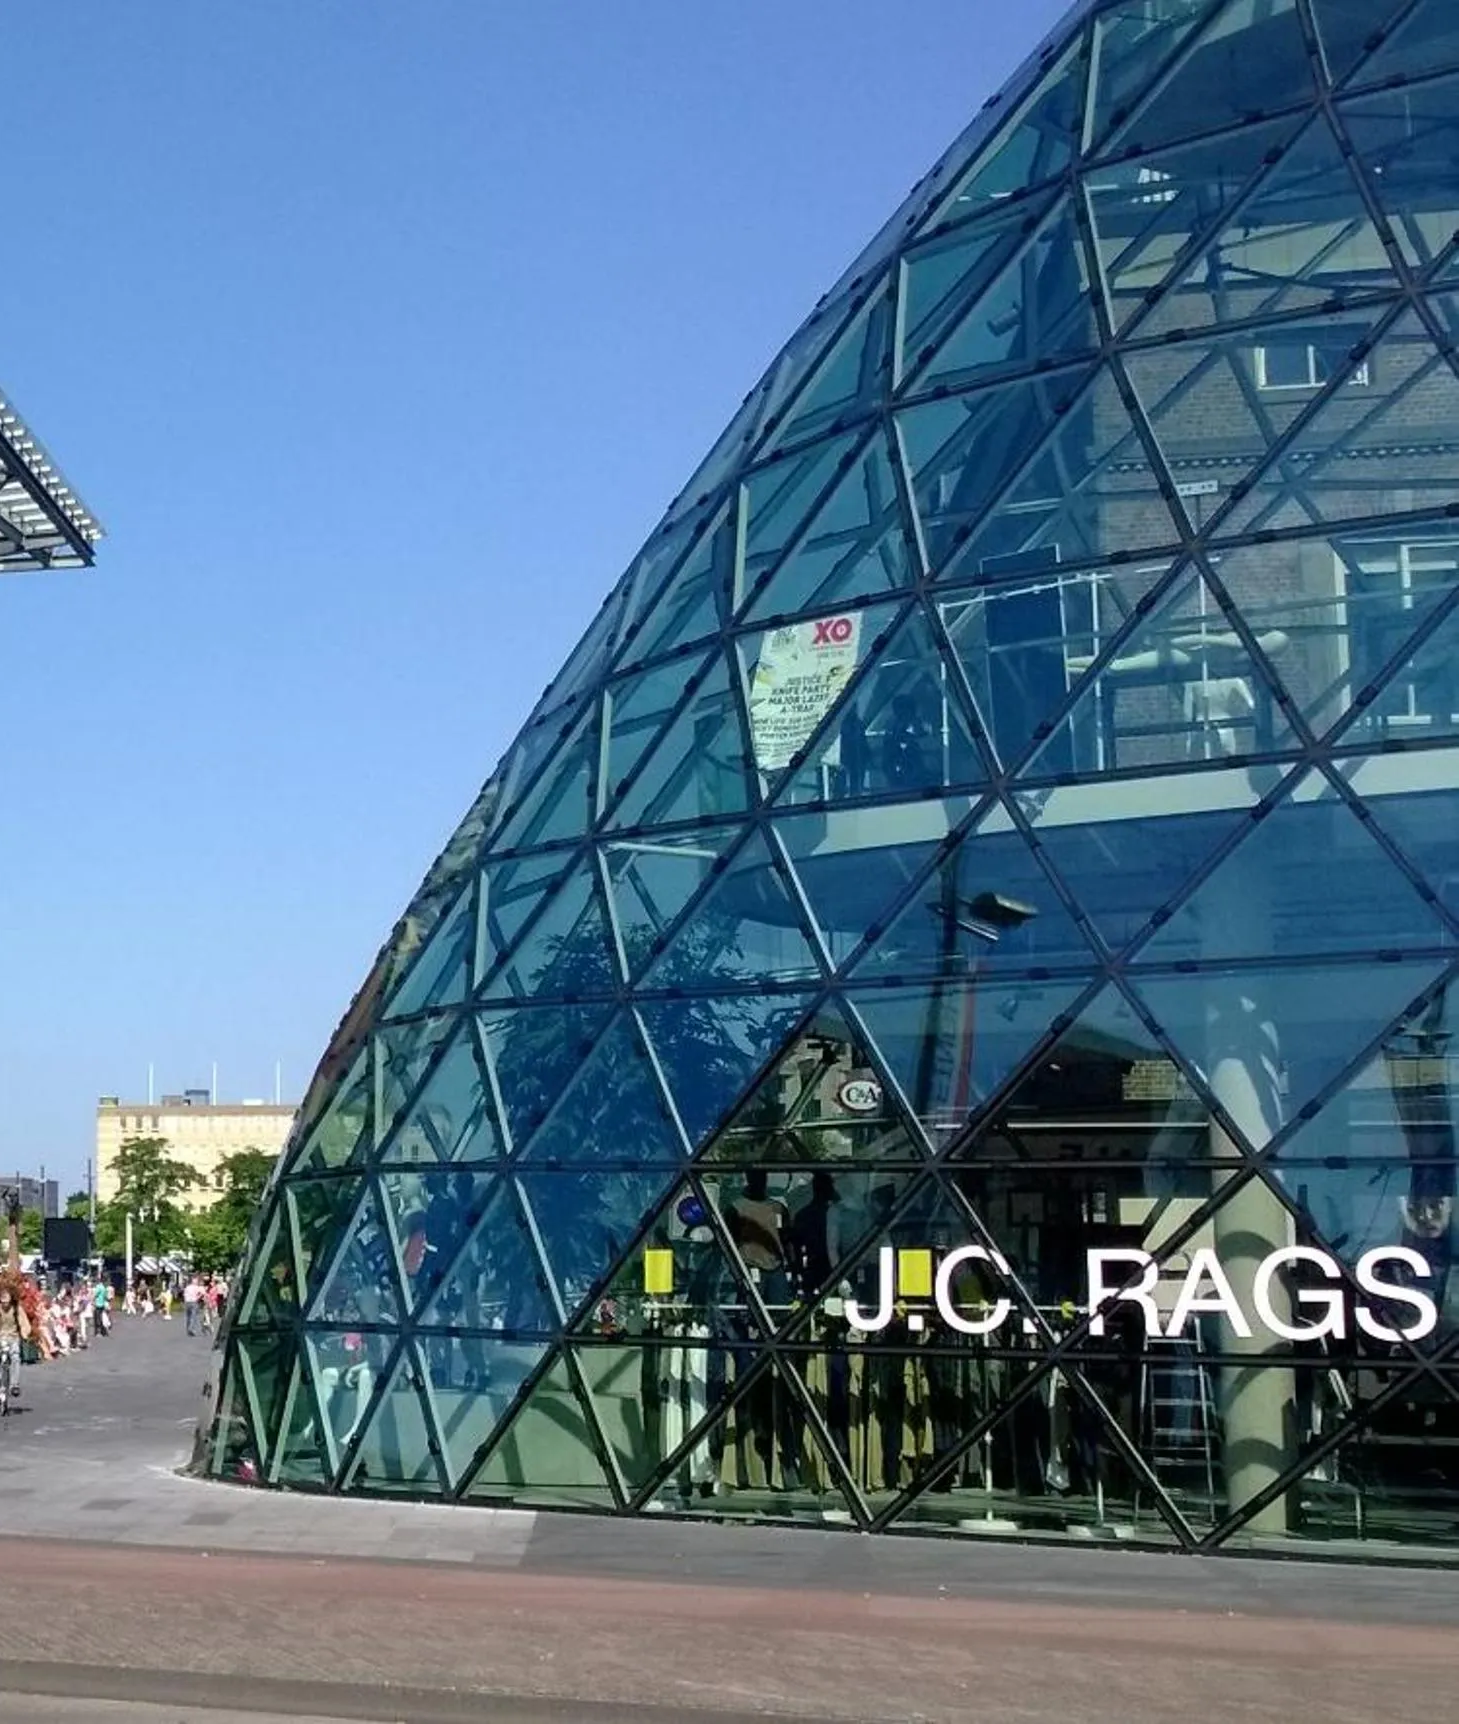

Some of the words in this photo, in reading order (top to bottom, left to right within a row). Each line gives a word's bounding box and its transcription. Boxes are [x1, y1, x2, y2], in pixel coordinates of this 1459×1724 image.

[812, 618, 852, 644] XO
[847, 1086, 879, 1104] C&A
[843, 1245, 1037, 1335] J.C.
[1087, 1245, 1438, 1343] RAGS
